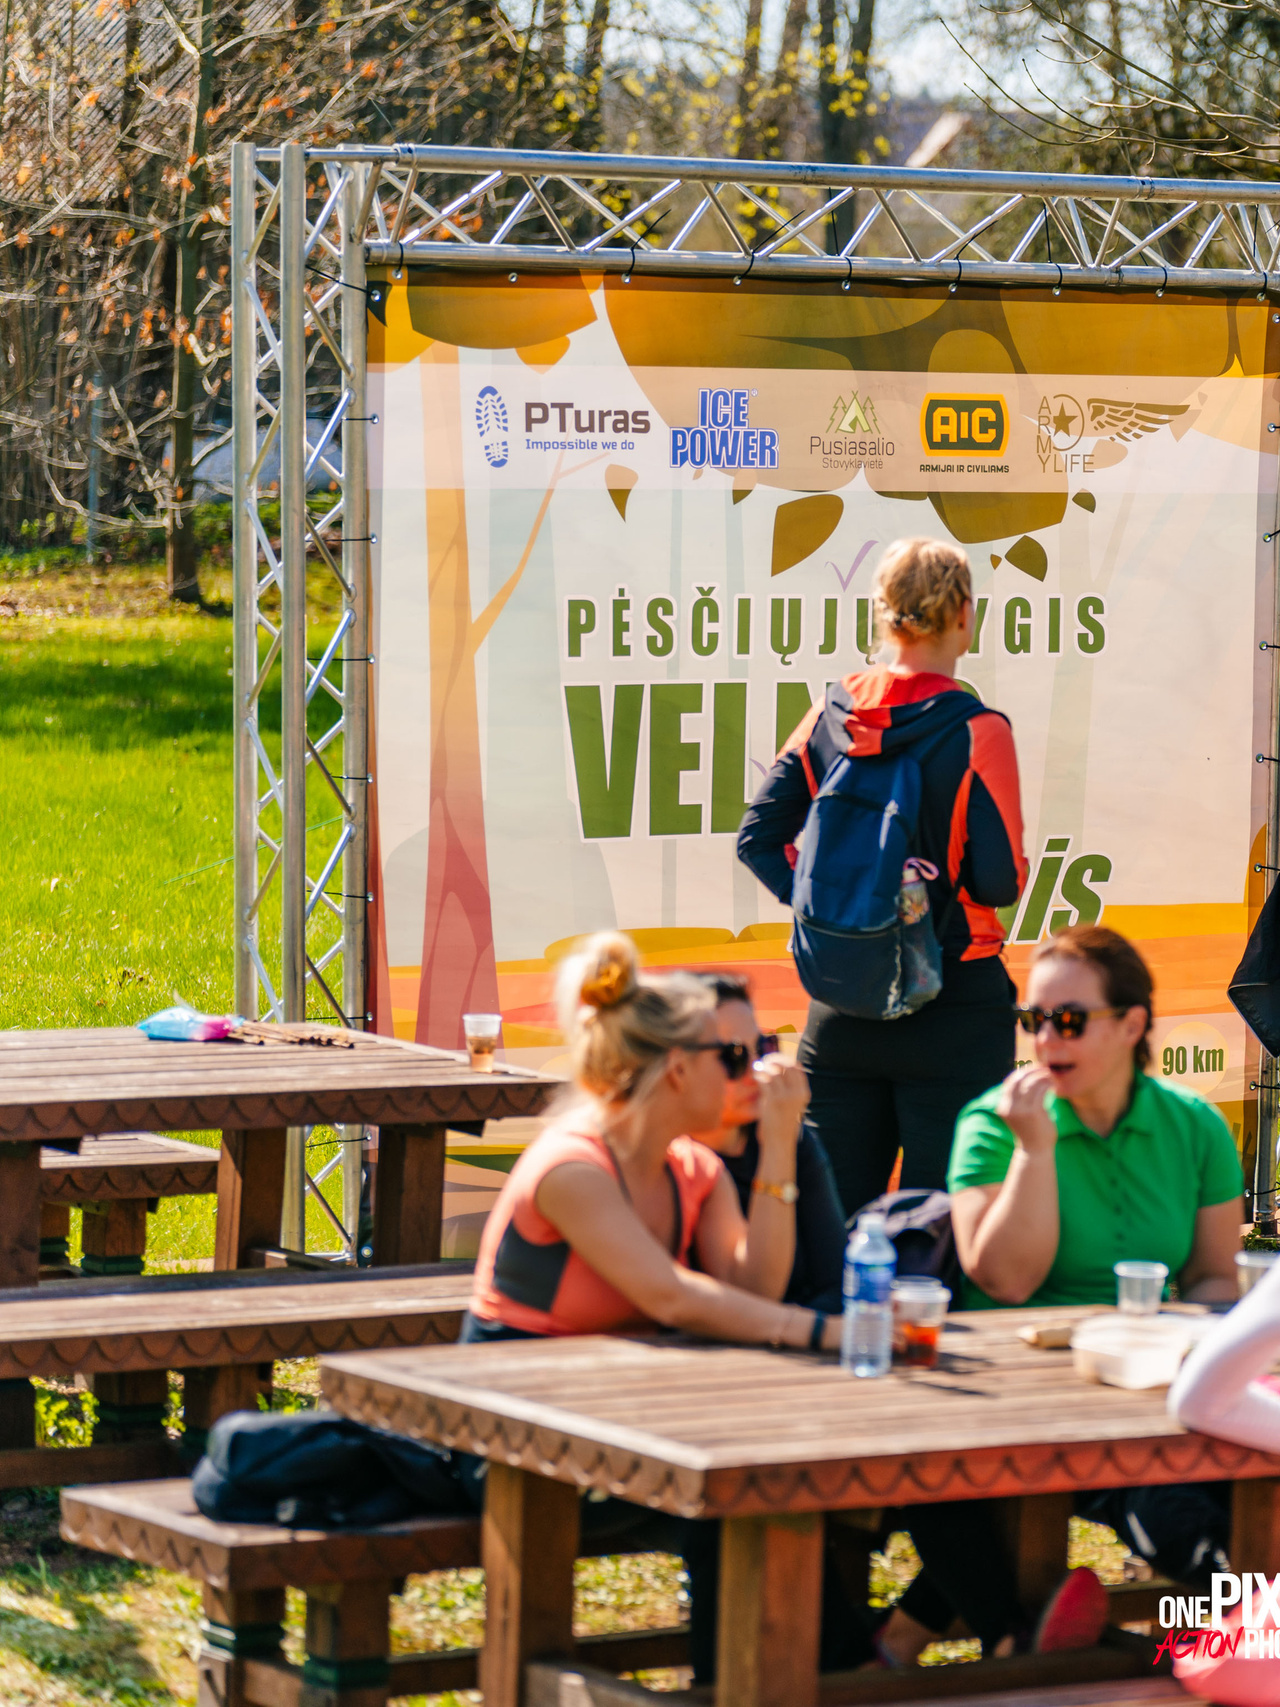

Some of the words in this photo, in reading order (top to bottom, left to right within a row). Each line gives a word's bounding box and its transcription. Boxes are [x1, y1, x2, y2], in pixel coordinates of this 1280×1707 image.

[525, 402, 651, 434] PTuras
[698, 388, 749, 429] ICE
[932, 406, 997, 443] AIC
[525, 439, 598, 452] Impossible
[601, 441, 618, 450] we
[620, 440, 635, 450] do
[669, 427, 779, 469] POWER
[810, 436, 895, 456] Pusiasalio
[822, 457, 884, 472] Stovyklavietė
[919, 464, 955, 473] ARMIJAI
[956, 464, 965, 473] IR
[966, 464, 1010, 473] CIVILIAMS
[967, 596, 1106, 655] YGIS
[1162, 1046, 1187, 1076] 90
[1193, 1045, 1224, 1074] km
